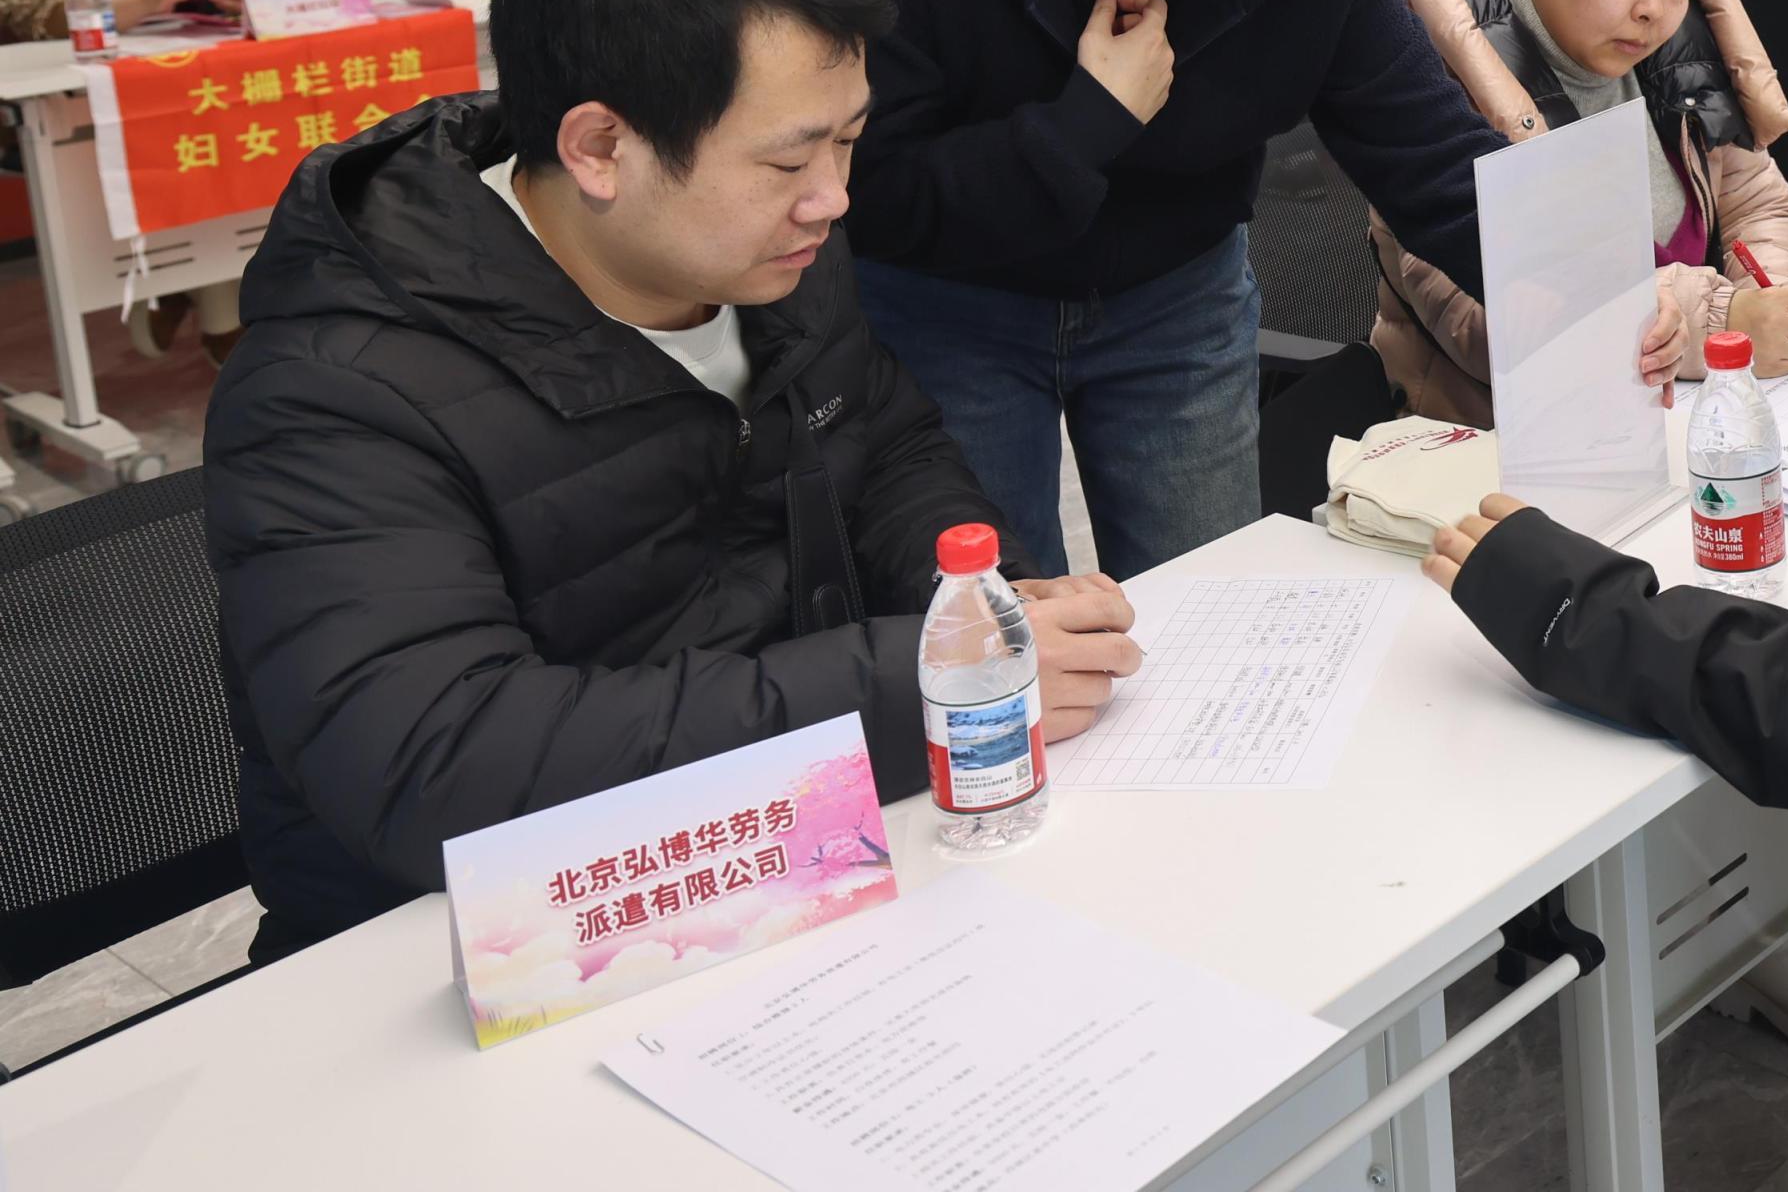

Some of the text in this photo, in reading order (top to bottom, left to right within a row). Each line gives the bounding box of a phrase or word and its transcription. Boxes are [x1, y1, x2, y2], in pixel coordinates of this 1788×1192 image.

[188, 48, 422, 115] 大栅栏街道
[174, 94, 431, 173] 妇女联合
[1716, 543, 1743, 553] SPRING
[548, 797, 797, 907] 北京弘博华劳务
[575, 844, 789, 943] 派遣有限公司
